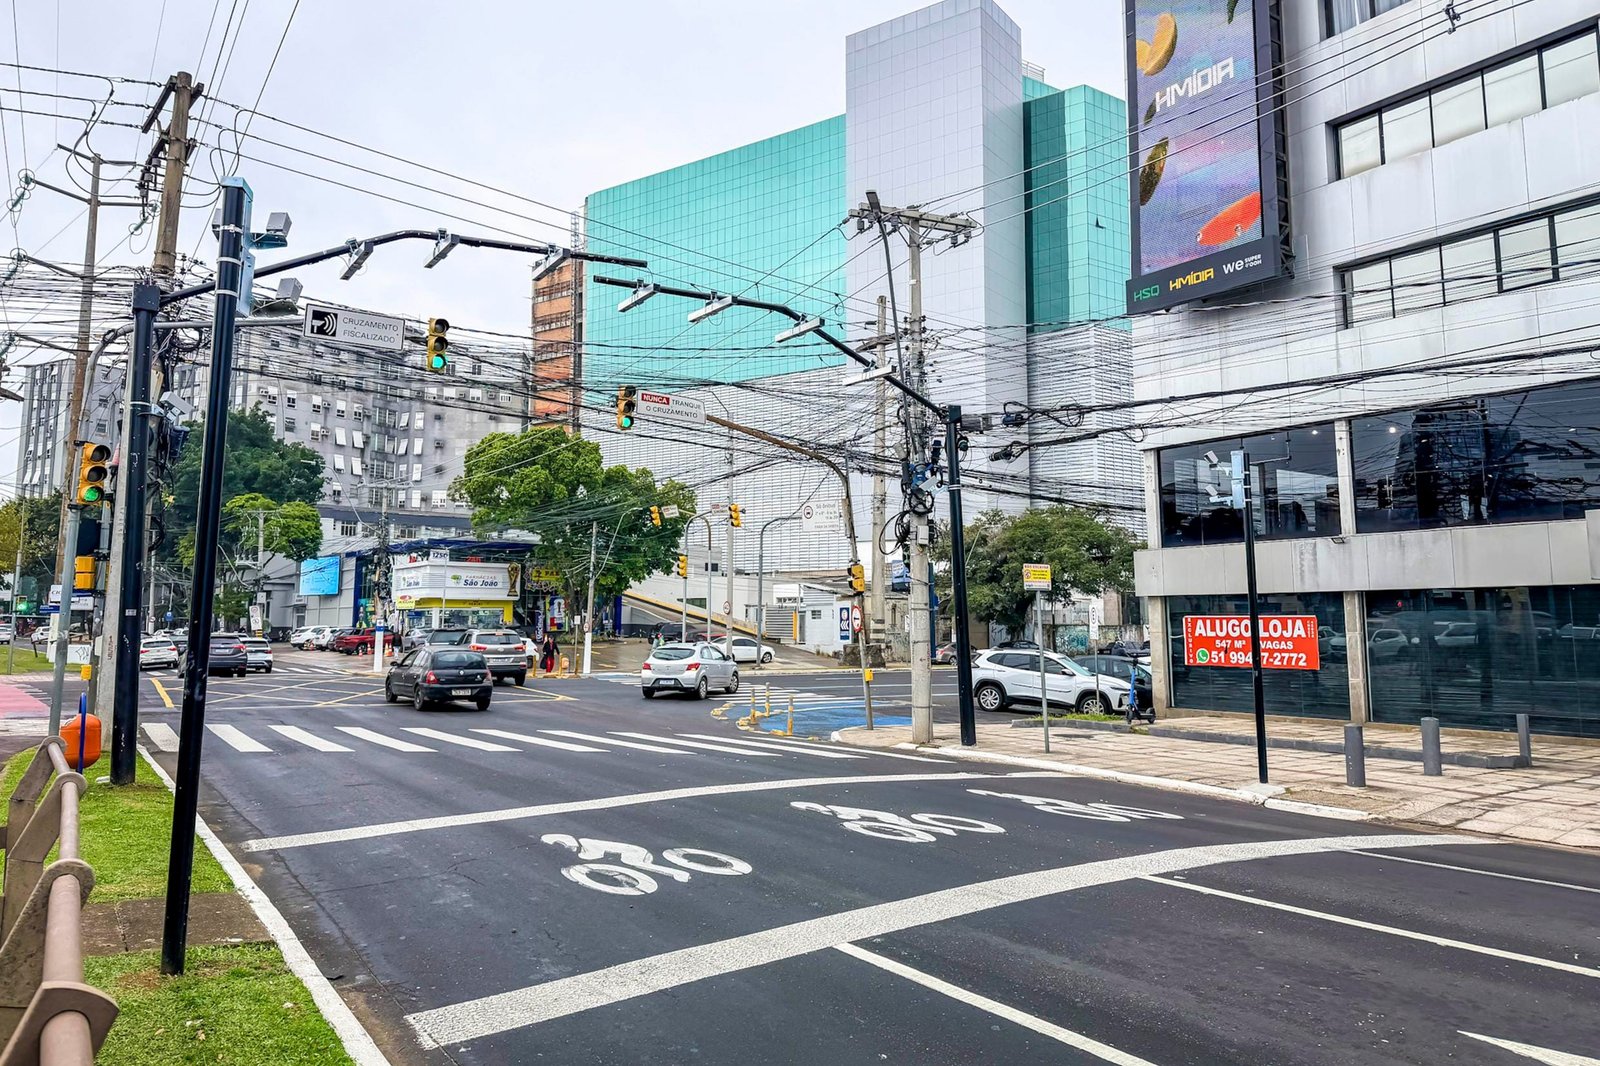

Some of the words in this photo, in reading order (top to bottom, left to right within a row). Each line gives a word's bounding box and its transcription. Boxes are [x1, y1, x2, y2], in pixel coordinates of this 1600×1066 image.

[1154, 57, 1234, 112] HMÍDIA
[1169, 267, 1215, 291] HMÍDIA
[1133, 284, 1160, 302] HSQ
[342, 317, 399, 331] CRUZAMENTO
[343, 329, 396, 343] FISCALIZADO
[643, 394, 668, 404] NUNCA
[672, 400, 701, 409] TRANQUE
[653, 407, 698, 418] CRUZAMENTO
[463, 579, 479, 587] São
[480, 579, 499, 587] João
[1195, 619, 1251, 637] ALUGO
[1259, 619, 1307, 638] LOJA
[1215, 640, 1231, 648] 547
[1259, 641, 1294, 650] VAGAS
[1211, 651, 1226, 663] 51
[1229, 651, 1307, 666] 9947-2772
